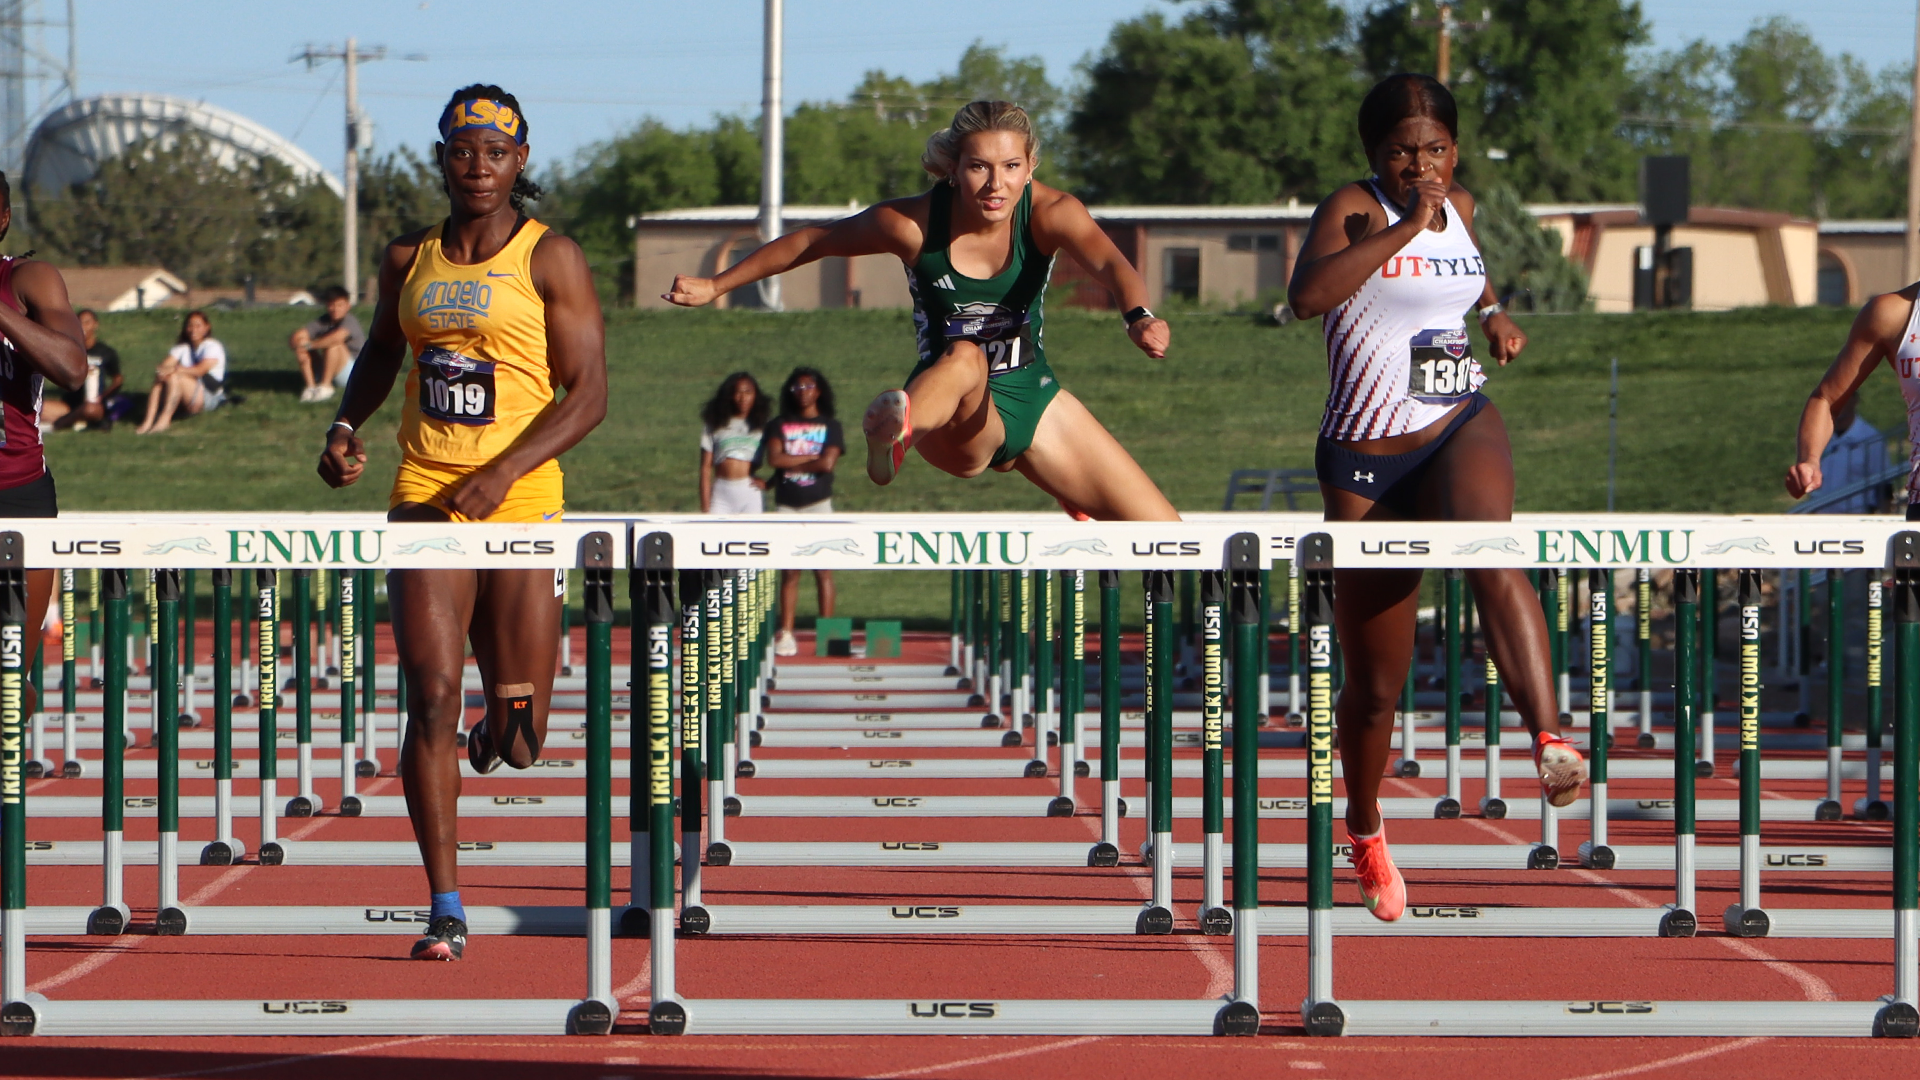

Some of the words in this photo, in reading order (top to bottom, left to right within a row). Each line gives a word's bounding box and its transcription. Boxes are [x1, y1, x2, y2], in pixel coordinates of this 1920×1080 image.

[1382, 256, 1423, 278] UT
[1428, 256, 1485, 276] TYLE
[418, 280, 492, 311] Angelo
[429, 312, 477, 328] STATE
[1420, 356, 1471, 394] 1387
[425, 376, 486, 415] 1019
[52, 540, 122, 555] UCS
[225, 530, 387, 563] ENMU
[485, 540, 555, 555] UCS
[701, 541, 770, 556] UCS
[873, 531, 1033, 564] ENMU
[1132, 541, 1201, 556] UCS
[1361, 540, 1430, 555] UCS
[1533, 530, 1695, 563] ENMU
[1794, 540, 1864, 554] UCS
[260, 589, 273, 617] USA
[342, 577, 353, 603] USA
[707, 589, 720, 618] USA
[722, 579, 733, 604] USA
[1592, 592, 1606, 620] USA
[1868, 581, 1882, 607] USA
[683, 604, 699, 639] USA
[1204, 605, 1221, 639] USA
[1742, 605, 1759, 640] USA
[2, 625, 22, 668] USA
[342, 605, 353, 682] TRACKTOWN
[650, 625, 669, 668] USA
[1310, 624, 1330, 668] USA
[1868, 609, 1882, 687] TRACKTOWN
[260, 620, 274, 710] TRACKTOWN
[707, 622, 721, 711] TRACKTOWN
[1592, 625, 1606, 714] TRACKTOWN
[683, 643, 699, 750] TRACKTOWN
[1204, 644, 1222, 751] TRACKTOWN
[1741, 644, 1758, 751] TRACKTOWN
[1, 673, 22, 804] TRACKTOWN
[650, 673, 671, 806] TRACKTOWN
[1310, 673, 1332, 806] TRACKTOWN
[125, 798, 157, 807] CS
[493, 797, 544, 805] UCS
[883, 842, 939, 850] UCS
[1767, 854, 1824, 865] UCS
[892, 906, 960, 918] UCS
[1412, 907, 1478, 918] UCS
[263, 1001, 347, 1014] UCS
[654, 1014, 683, 1022] UCS
[911, 1002, 995, 1017] UCS
